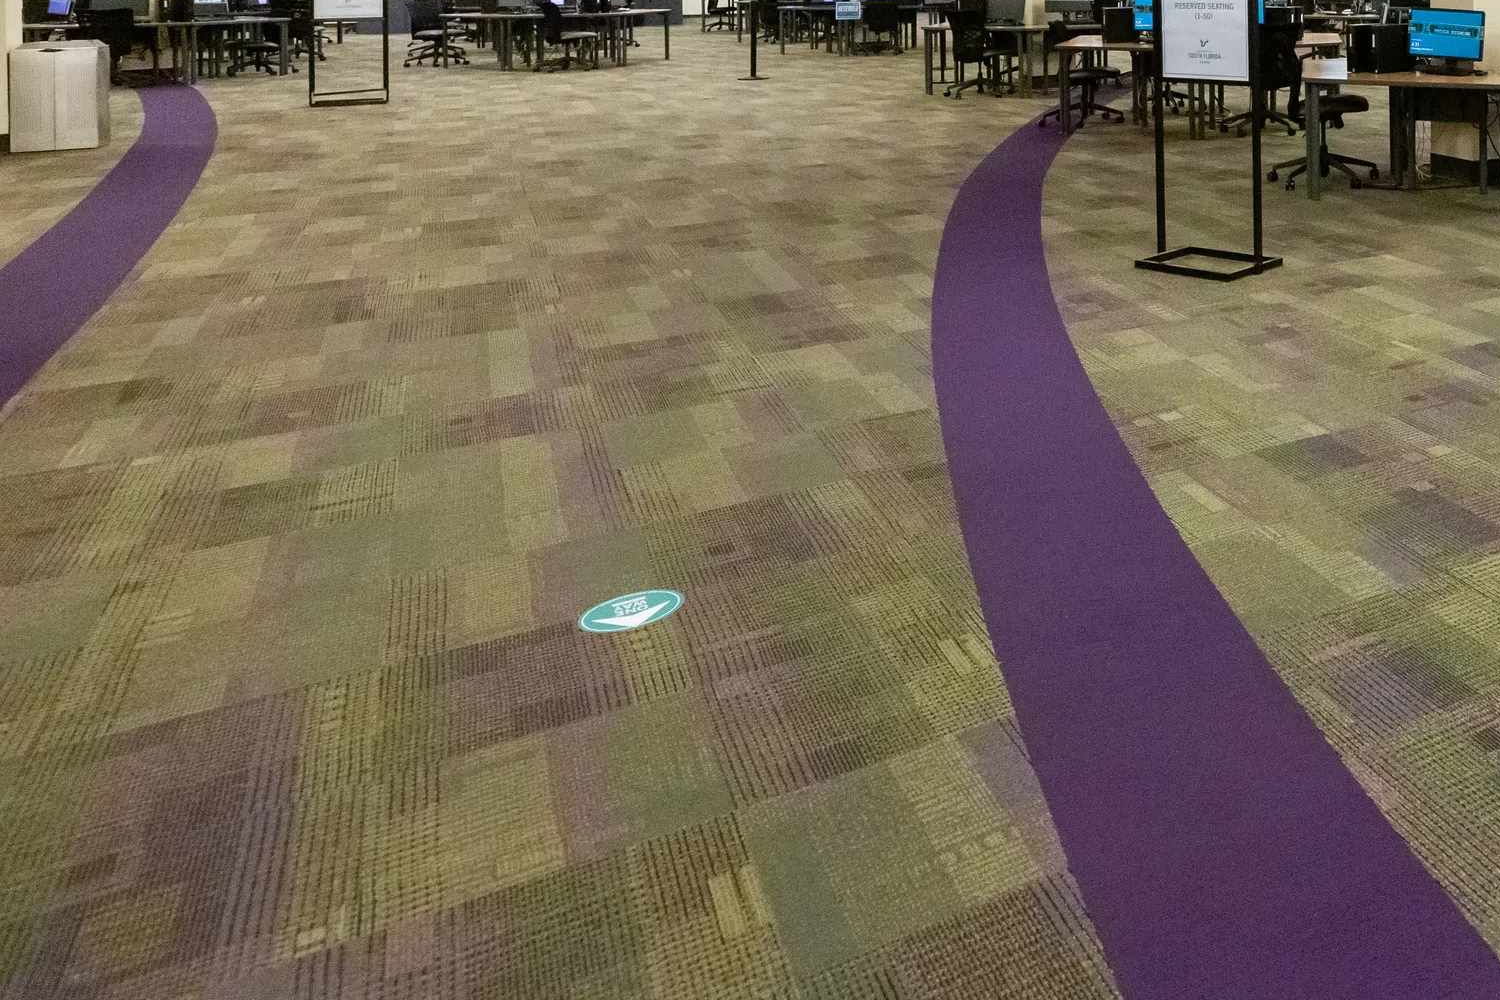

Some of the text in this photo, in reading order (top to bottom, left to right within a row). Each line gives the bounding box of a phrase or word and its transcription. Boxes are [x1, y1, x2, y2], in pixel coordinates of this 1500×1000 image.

[1174, 2, 1234, 11] RESERVED SEATING
[1194, 12, 1213, 20] (1-50)
[614, 599, 647, 612] WAY
[614, 604, 649, 617] ONE
